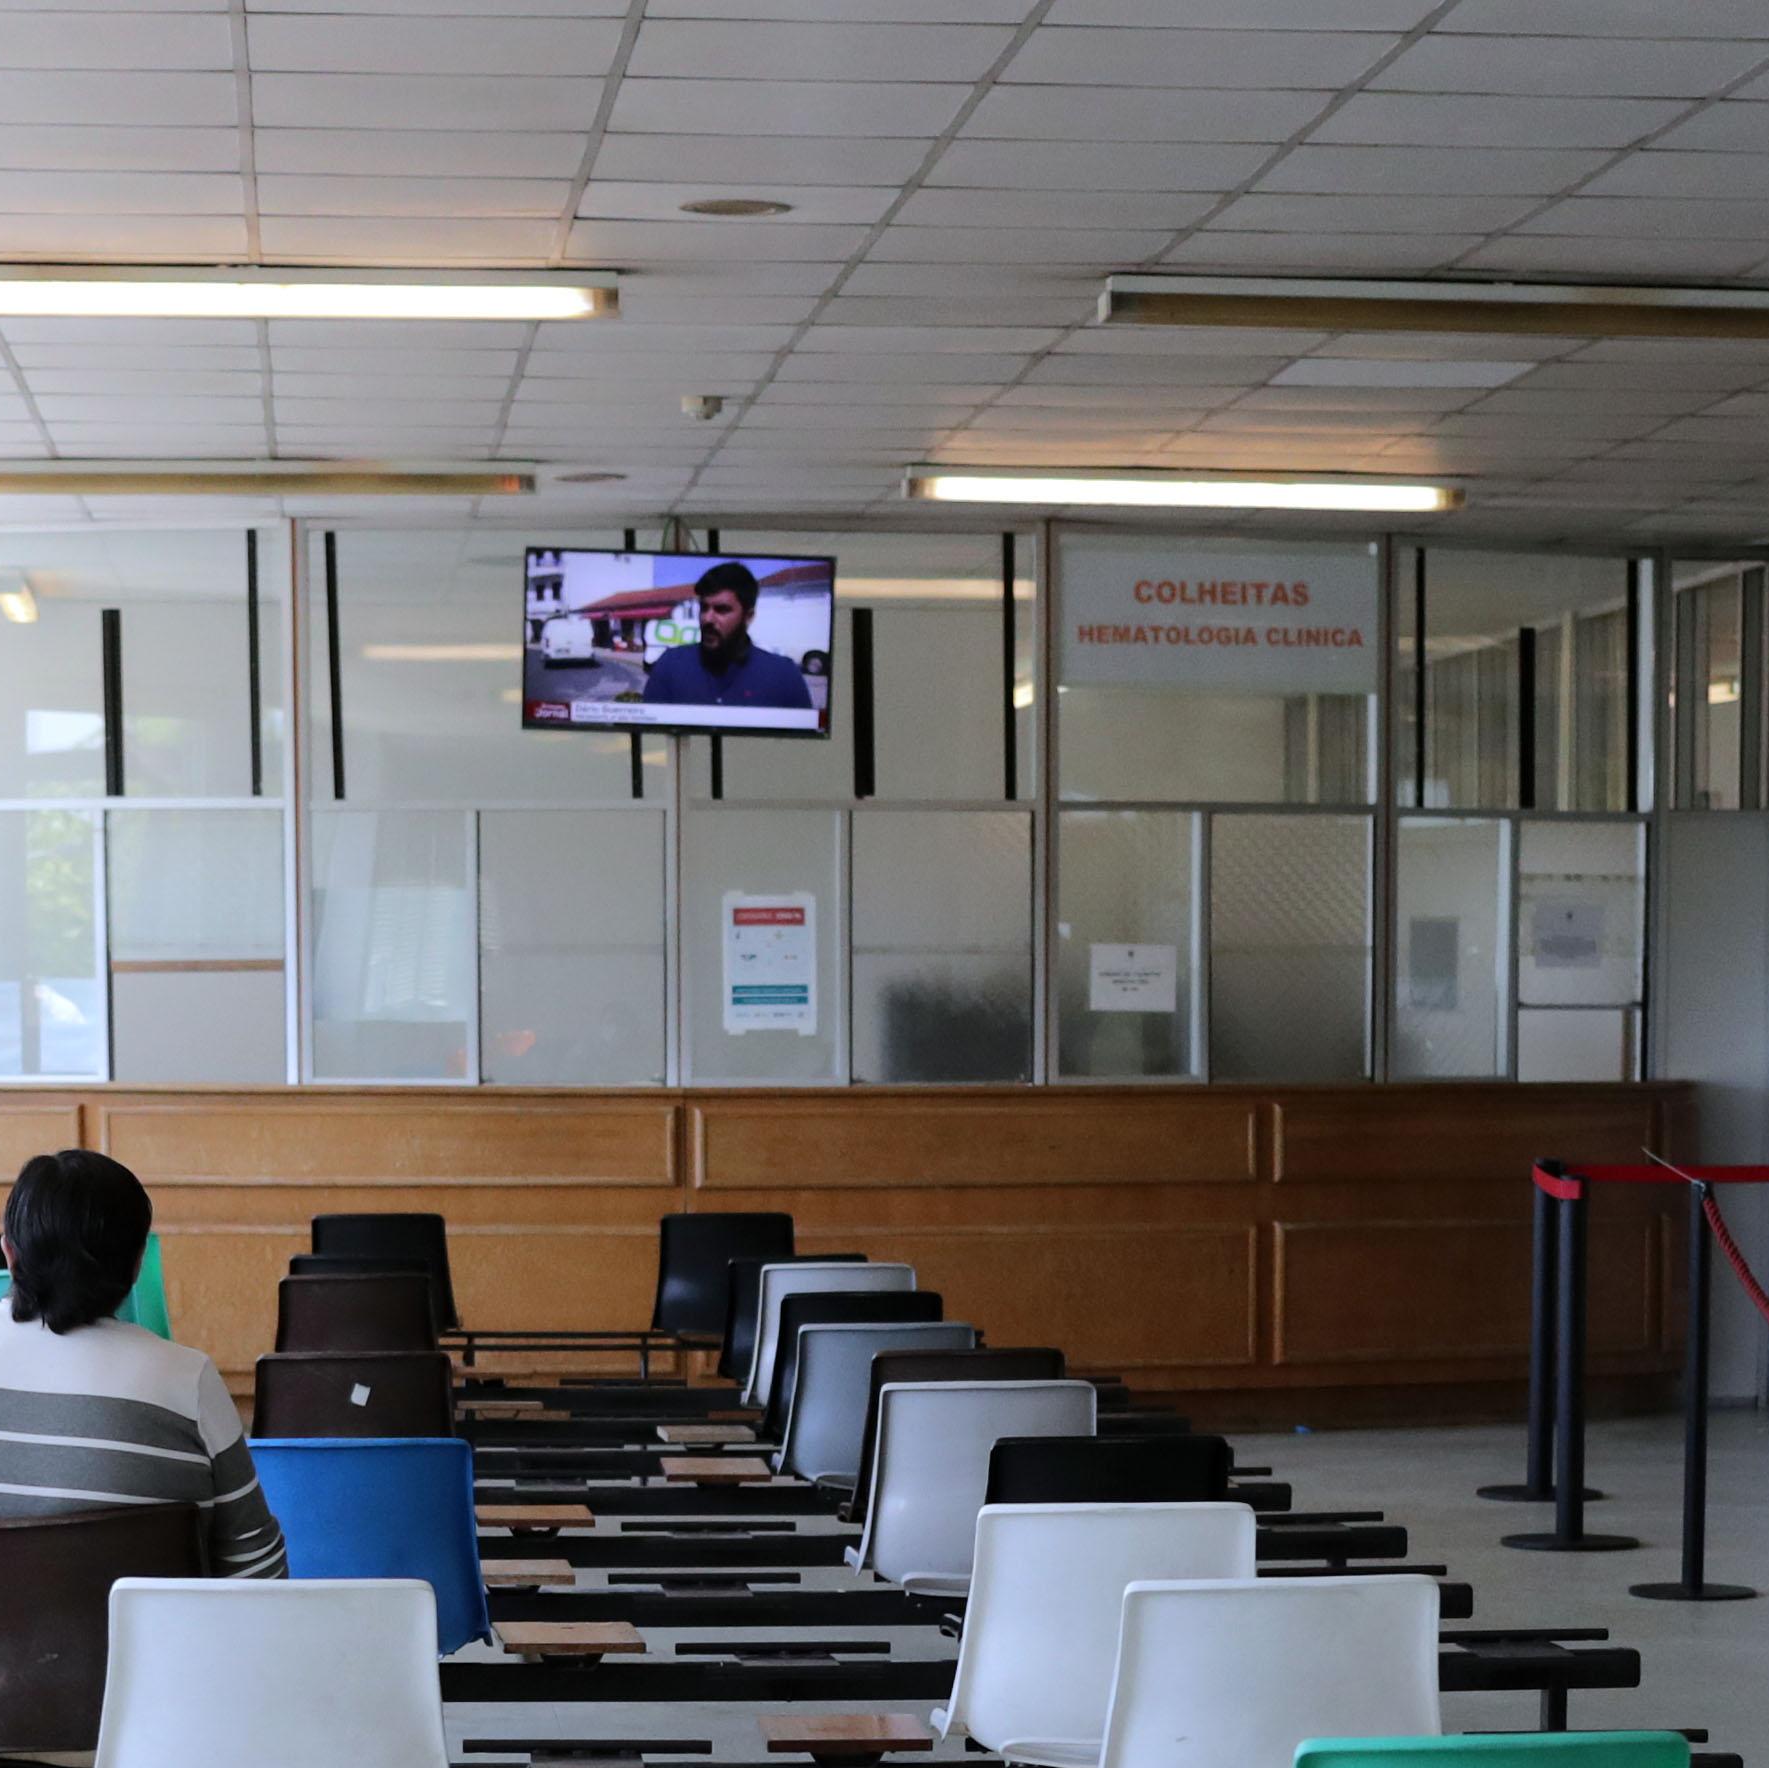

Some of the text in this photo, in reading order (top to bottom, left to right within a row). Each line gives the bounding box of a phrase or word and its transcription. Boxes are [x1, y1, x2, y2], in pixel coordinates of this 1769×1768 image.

[1133, 579, 1310, 607] COLHEITAS
[1078, 624, 1363, 649] HEMATOLOGIA CLINICA
